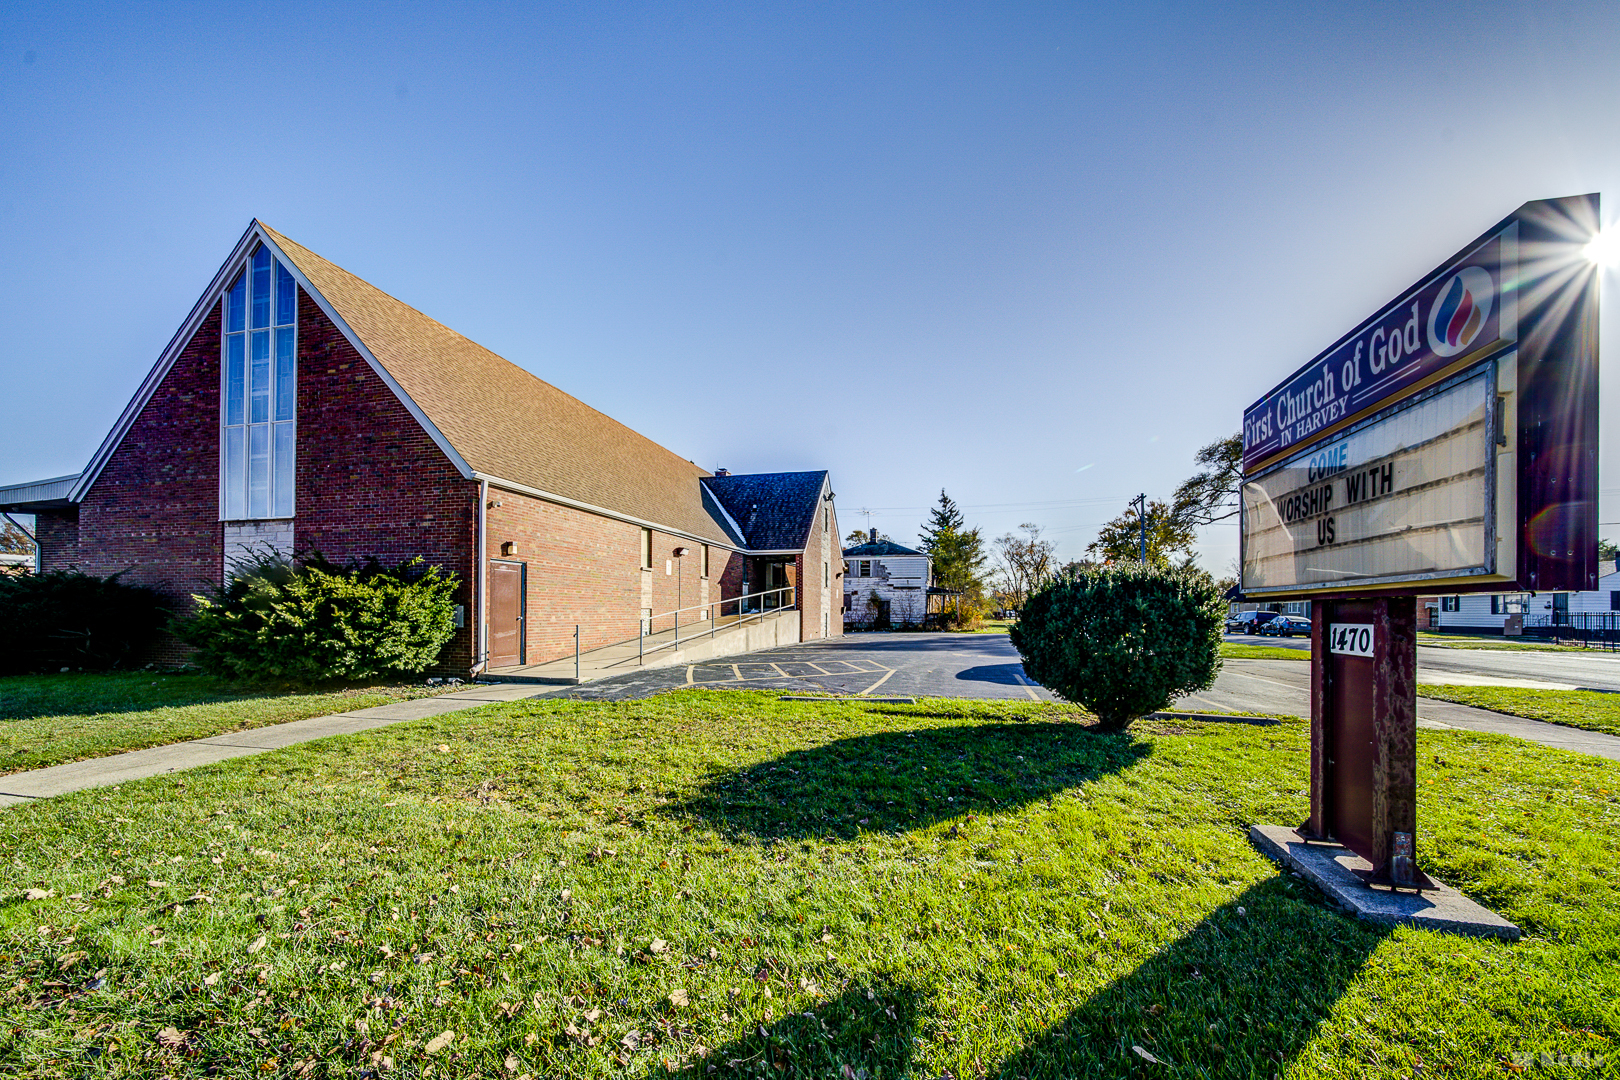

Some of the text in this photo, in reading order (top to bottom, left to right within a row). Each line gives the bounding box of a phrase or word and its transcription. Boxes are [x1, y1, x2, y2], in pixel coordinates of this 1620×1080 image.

[1244, 300, 1421, 451] First Church of God
[1280, 394, 1349, 448] IN HARVEY
[1308, 443, 1348, 483] COME
[1277, 462, 1393, 524] WORSHIP WITH
[1318, 516, 1335, 546] US
[1331, 627, 1370, 653] 1470
